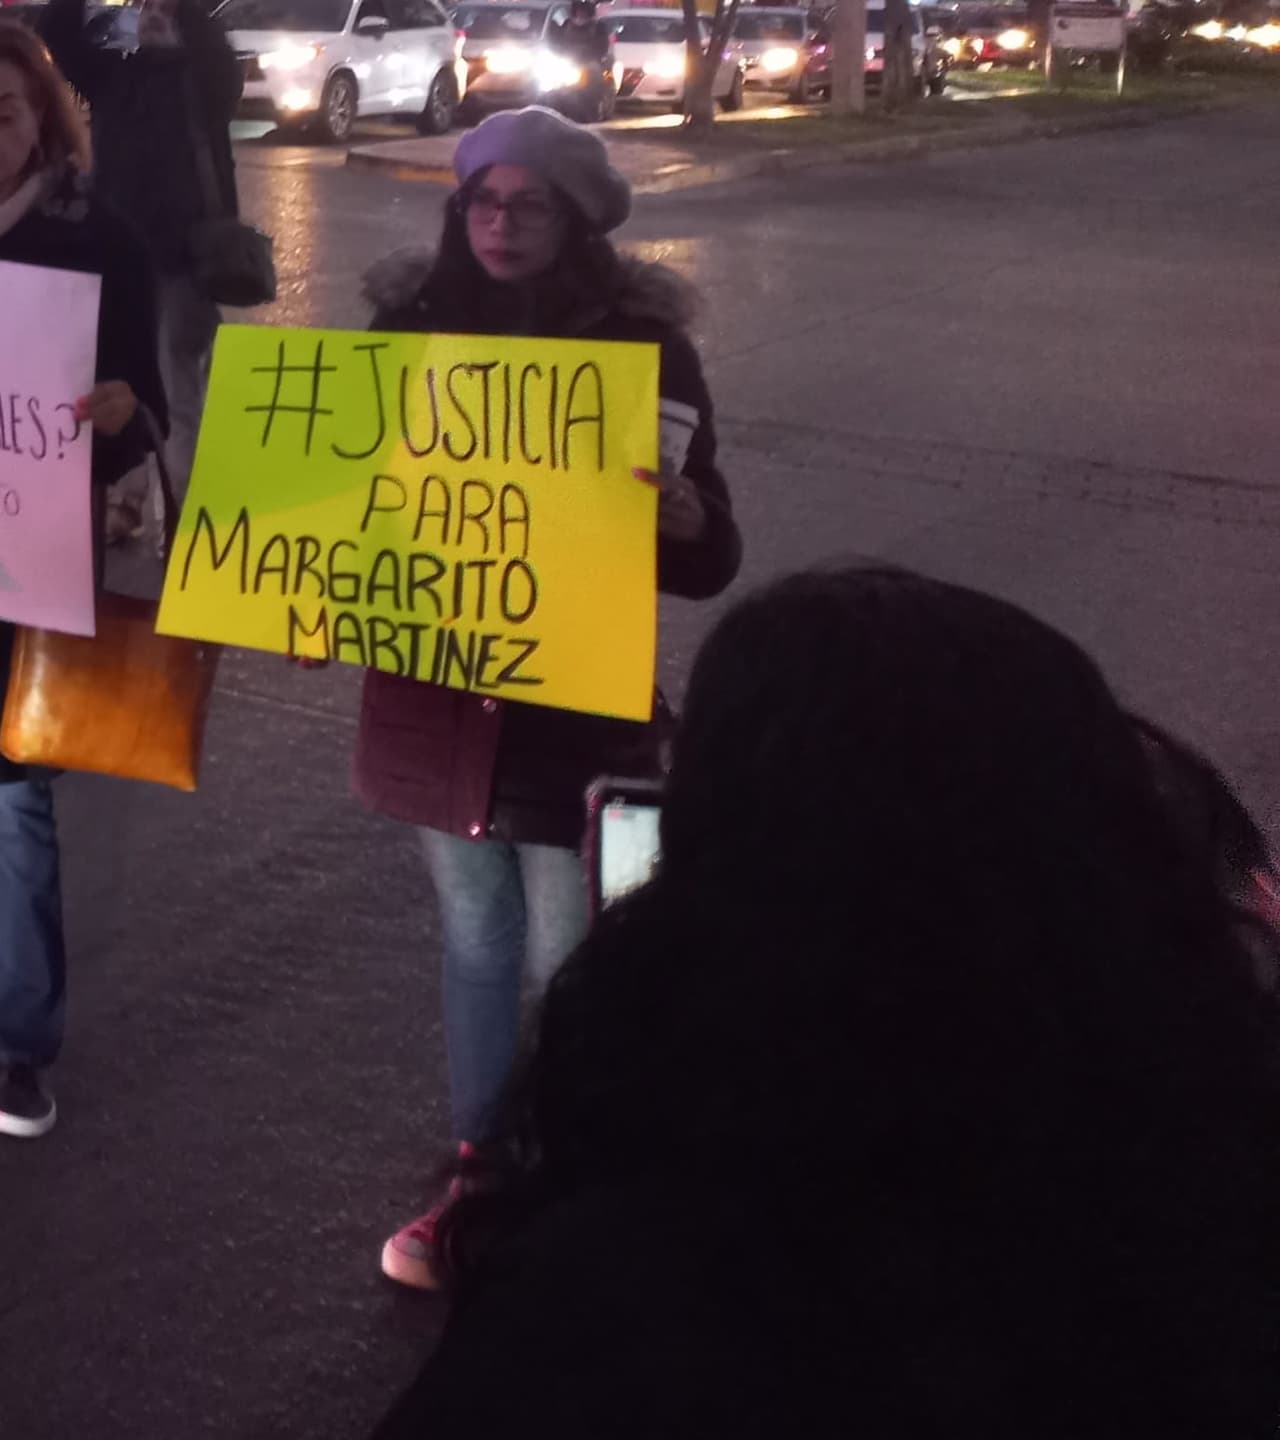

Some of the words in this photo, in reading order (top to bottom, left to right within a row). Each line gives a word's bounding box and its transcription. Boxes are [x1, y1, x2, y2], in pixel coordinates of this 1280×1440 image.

[244, 339, 606, 473] #JUSTICIA
[180, 506, 539, 625] MARGARITO
[359, 474, 532, 560] PARA
